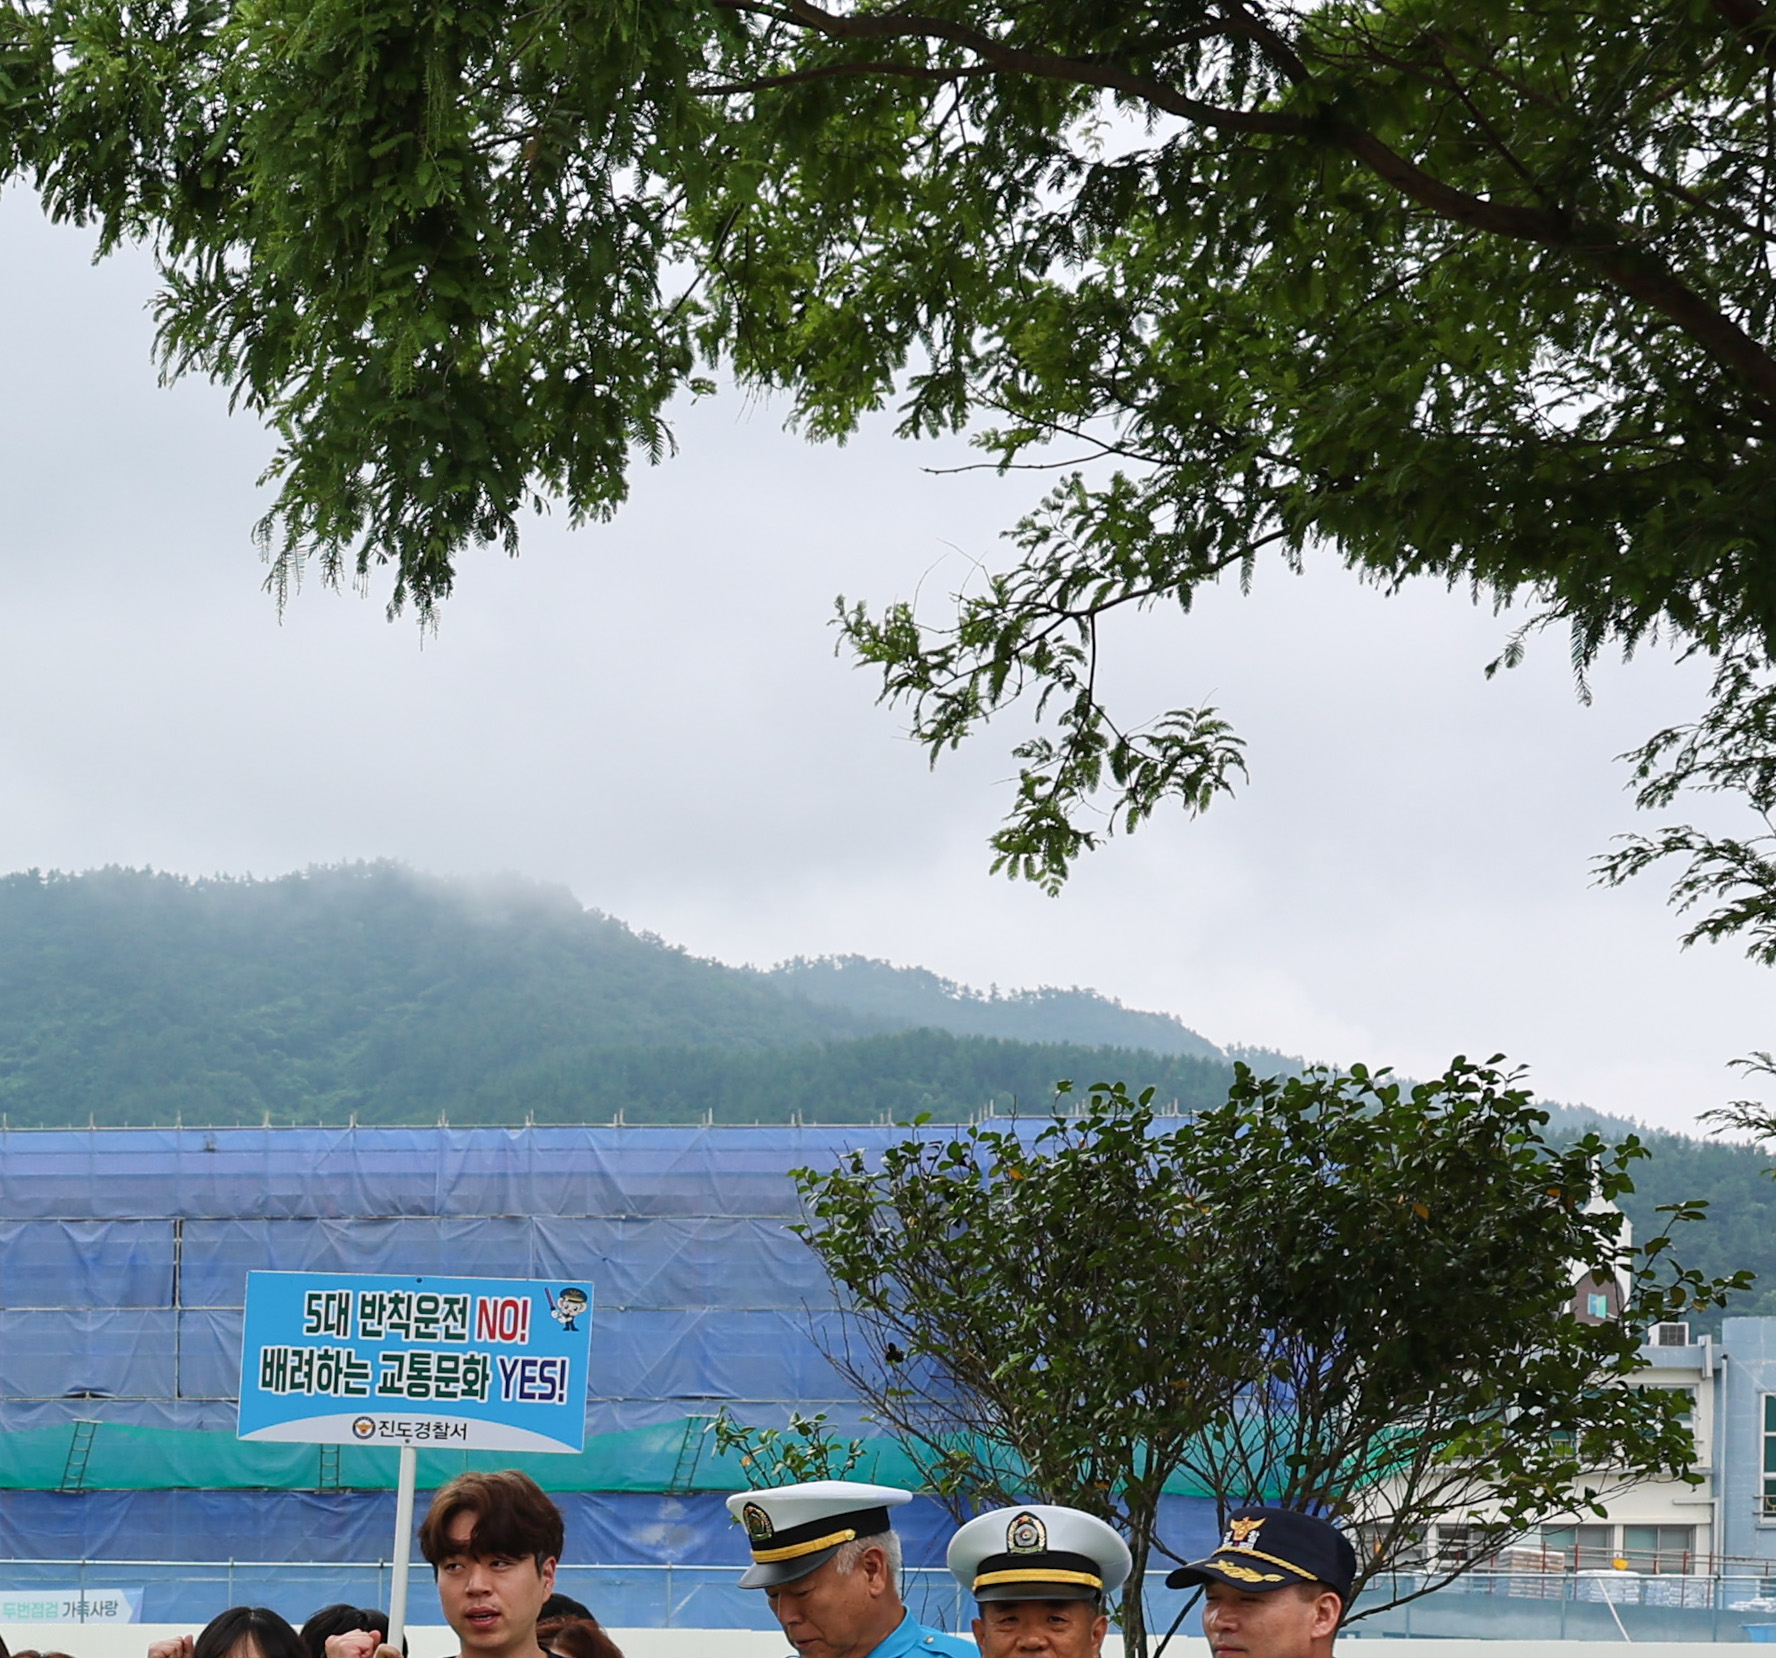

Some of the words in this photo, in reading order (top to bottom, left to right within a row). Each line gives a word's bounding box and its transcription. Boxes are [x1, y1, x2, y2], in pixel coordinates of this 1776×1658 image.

[306, 1292, 350, 1337] 5대
[360, 1293, 468, 1341] 반칙운전
[477, 1299, 530, 1342] NO!
[260, 1348, 370, 1395] 배려하는
[378, 1353, 489, 1400] 교통문화
[499, 1357, 567, 1403] YES!
[378, 1420, 468, 1440] 진도경찰서
[3, 1602, 58, 1618] 두번점검
[63, 1601, 118, 1618] 가족사랑
